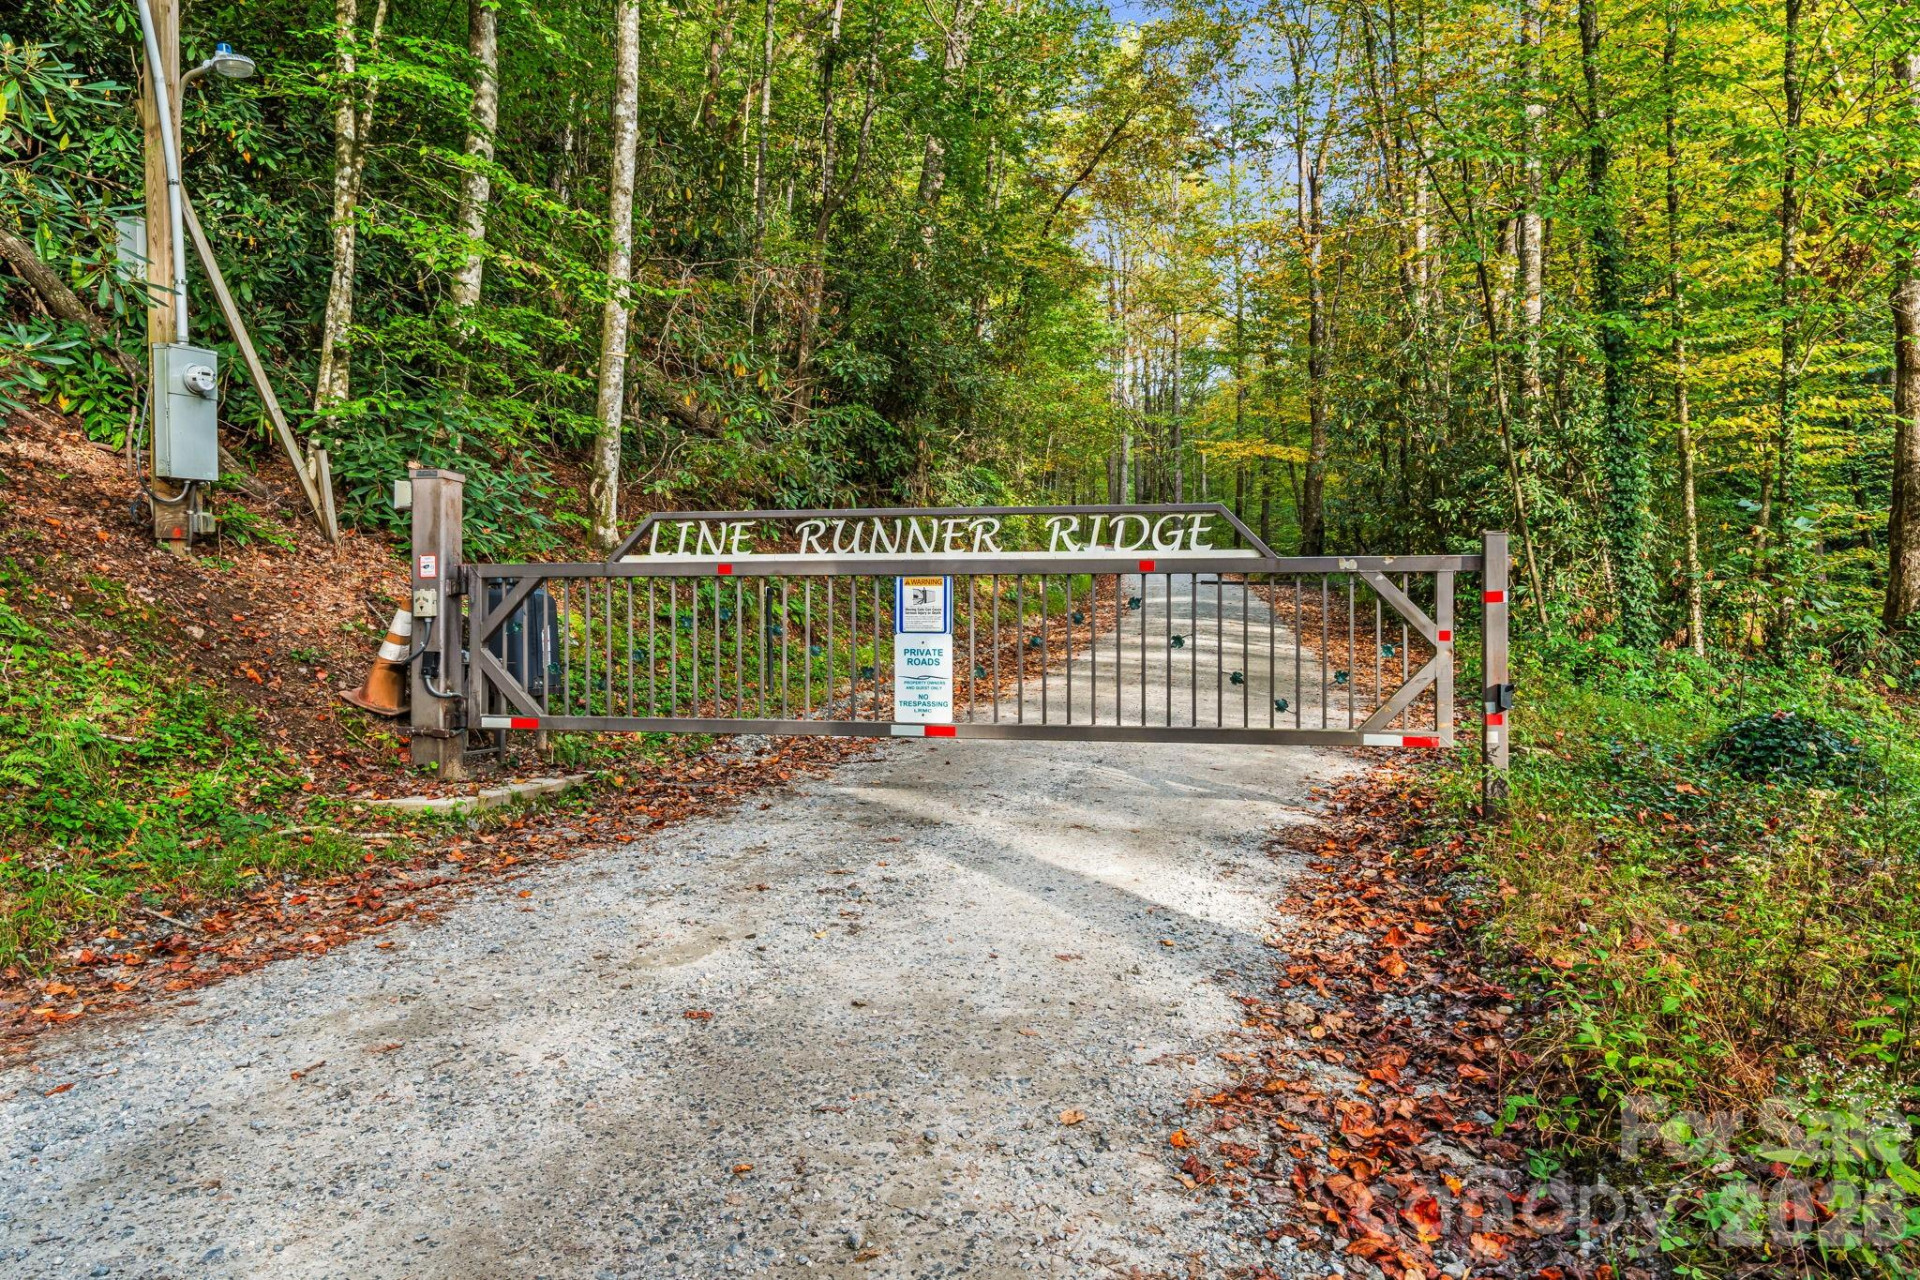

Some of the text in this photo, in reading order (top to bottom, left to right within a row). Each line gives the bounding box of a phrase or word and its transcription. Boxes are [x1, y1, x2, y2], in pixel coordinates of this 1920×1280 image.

[649, 511, 1216, 556] LINE RUNNER RIDGE
[903, 648, 944, 656] PRIVATE
[907, 658, 941, 666] ROADS
